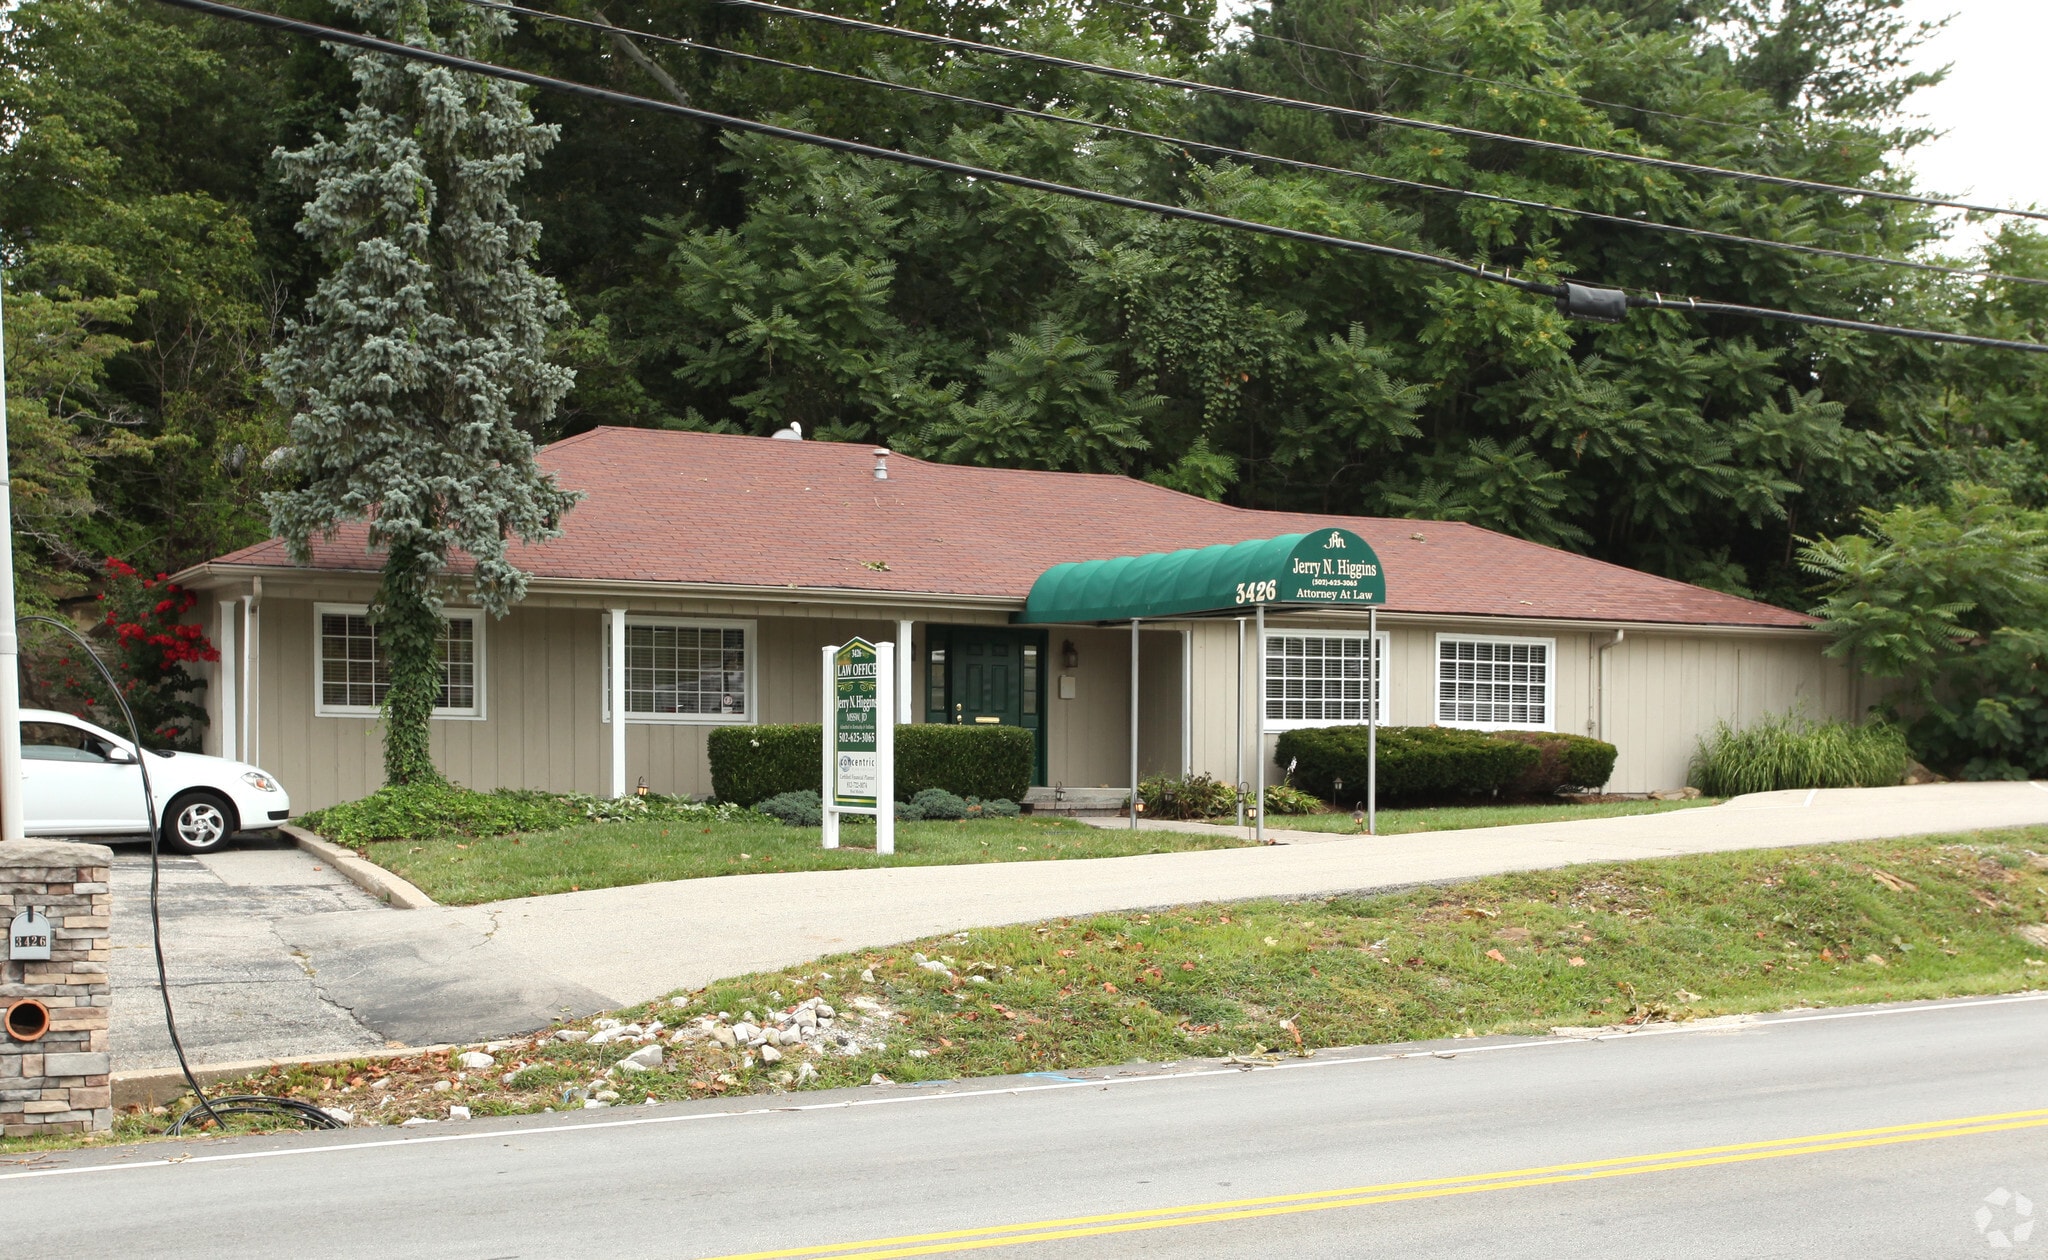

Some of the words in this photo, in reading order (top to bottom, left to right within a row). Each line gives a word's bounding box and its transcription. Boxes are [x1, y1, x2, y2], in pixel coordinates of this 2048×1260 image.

[1293, 558, 1320, 577] Jerry
[1323, 559, 1334, 575] N.
[1337, 559, 1376, 579] Higgins
[1235, 579, 1276, 604] 3426
[1296, 588, 1337, 600] Attorney
[1340, 590, 1350, 599] At
[1353, 590, 1372, 599] Law
[837, 664, 851, 676] LAW
[853, 663, 876, 675] OFFICE
[837, 695, 849, 712] Jerry
[838, 732, 875, 743] 502-625-3065
[840, 757, 875, 767] concentric
[15, 936, 46, 947] 3426
